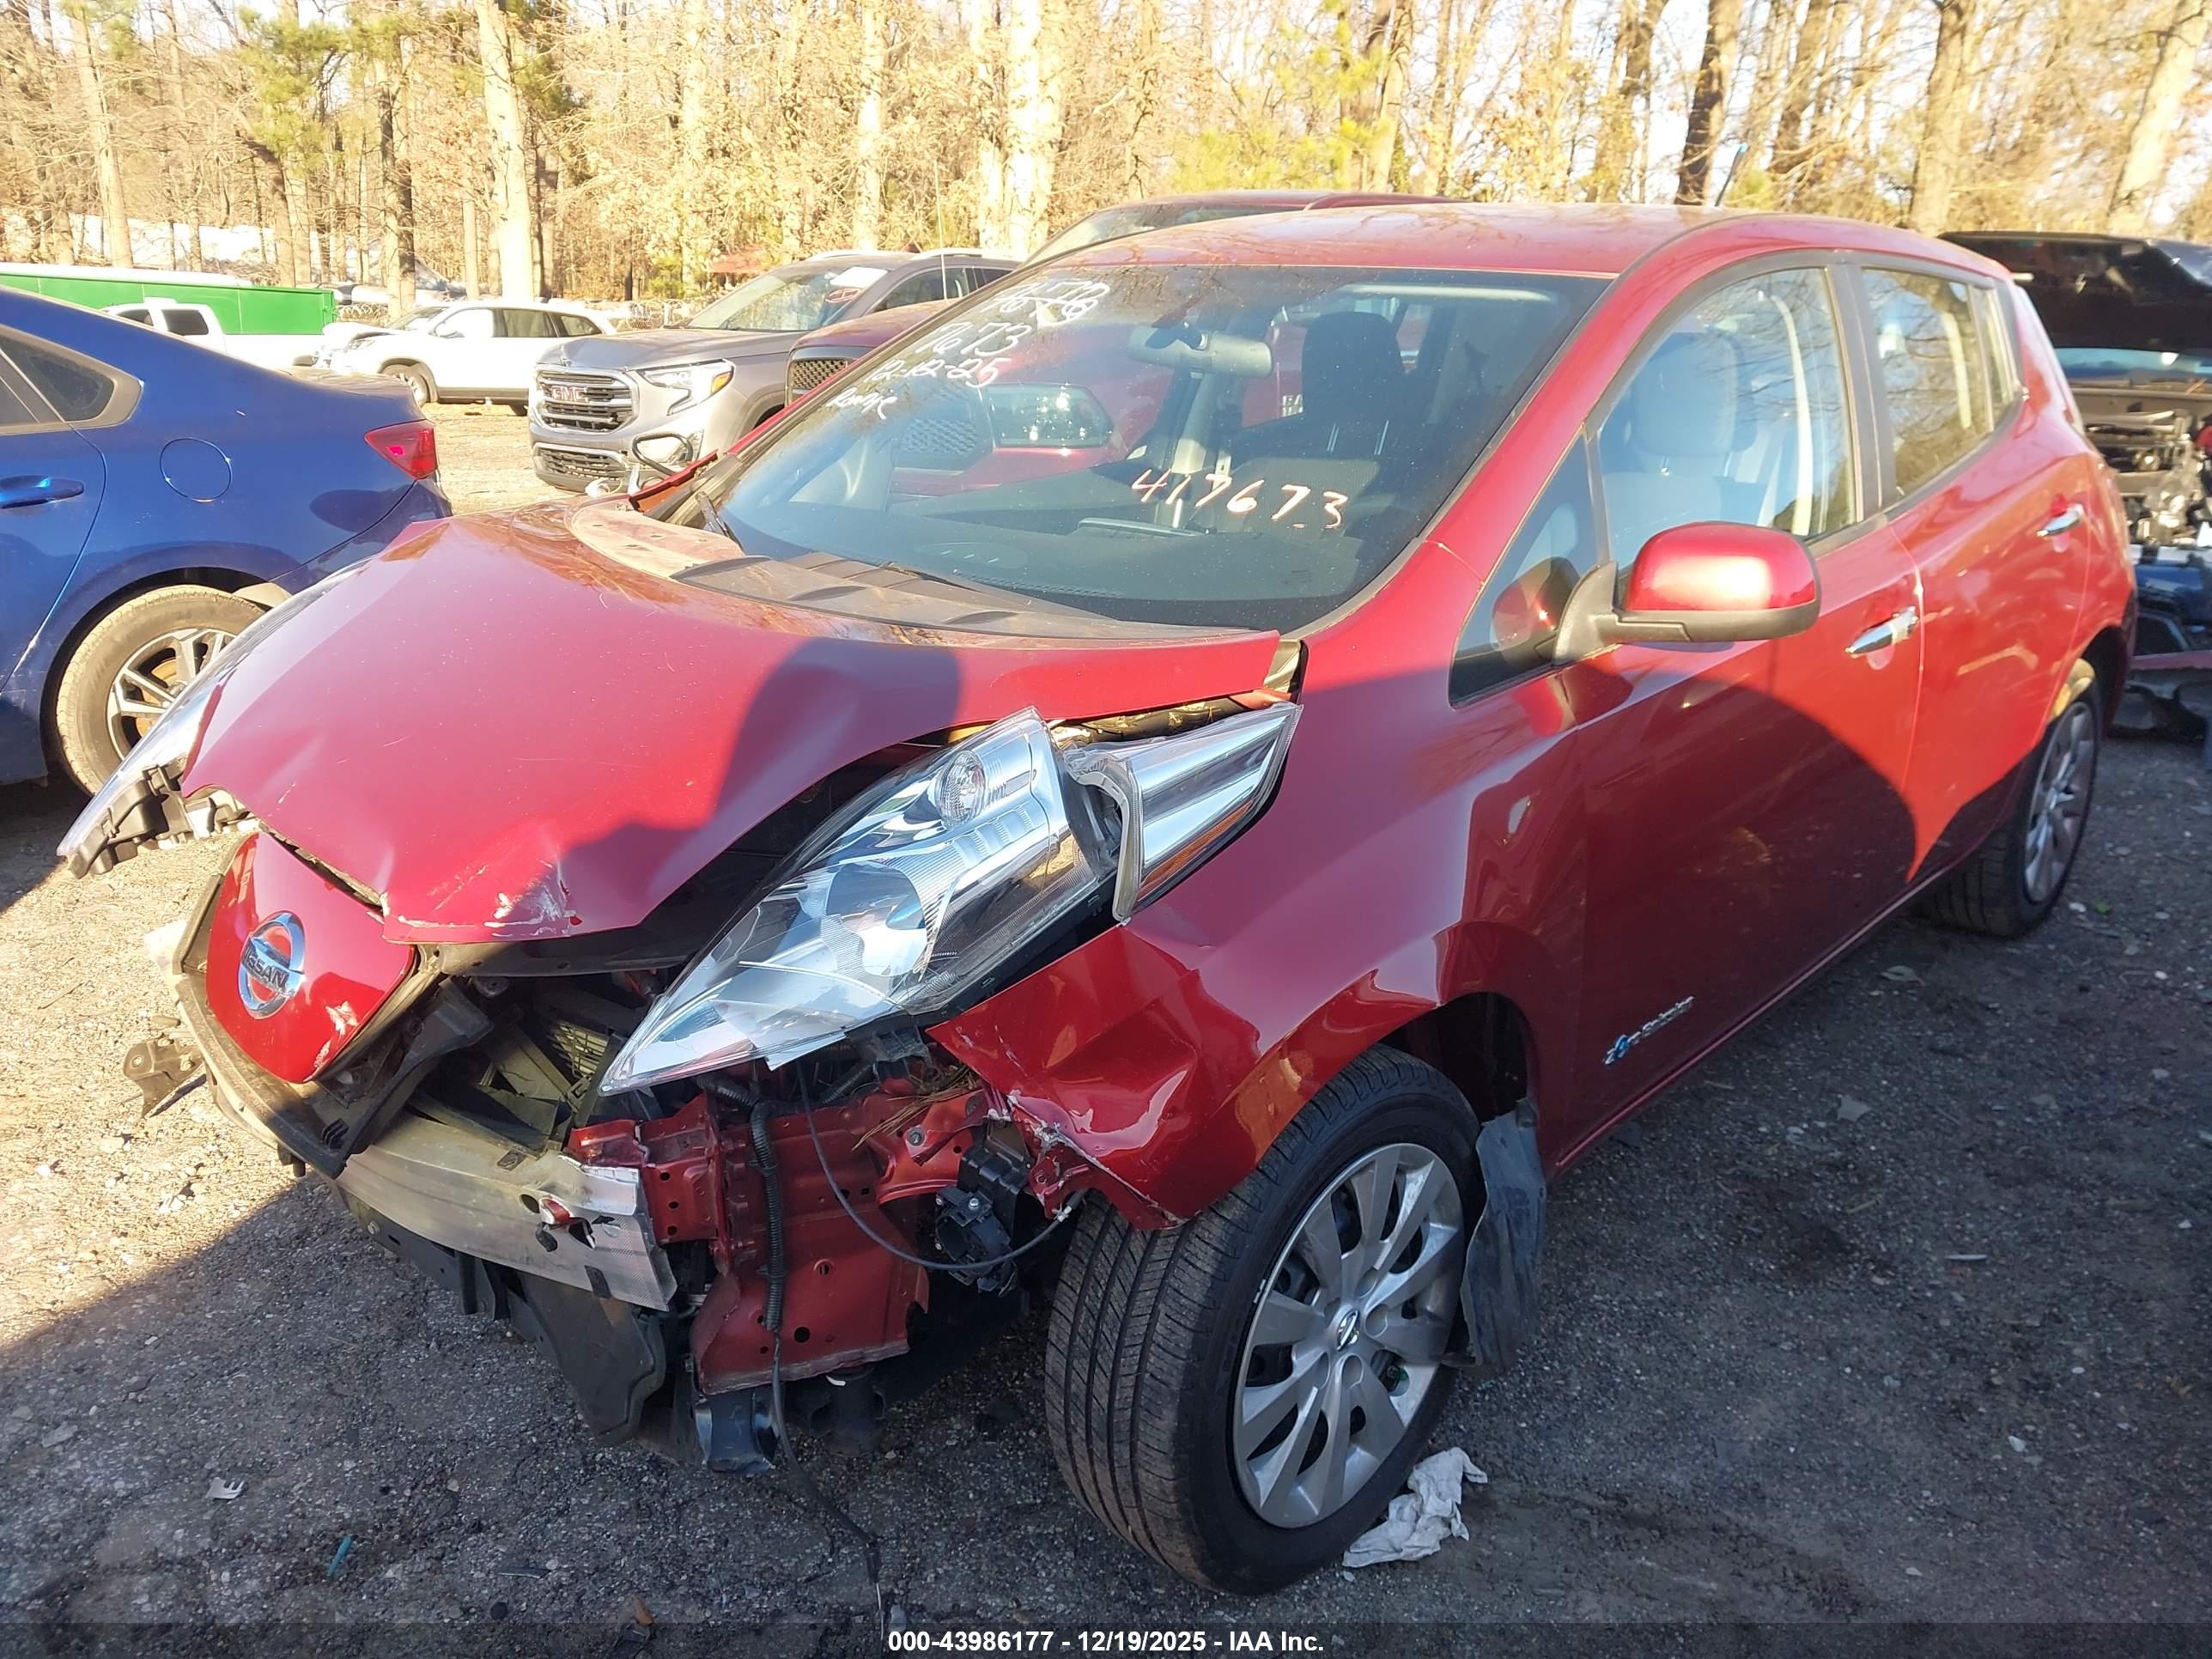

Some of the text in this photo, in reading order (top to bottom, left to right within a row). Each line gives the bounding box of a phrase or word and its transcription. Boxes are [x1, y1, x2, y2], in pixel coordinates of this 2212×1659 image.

[918, 322, 1031, 356] 7673
[864, 357, 1012, 386] 12-12-25
[551, 386, 588, 402] GMC
[1131, 468, 1348, 529] 417673
